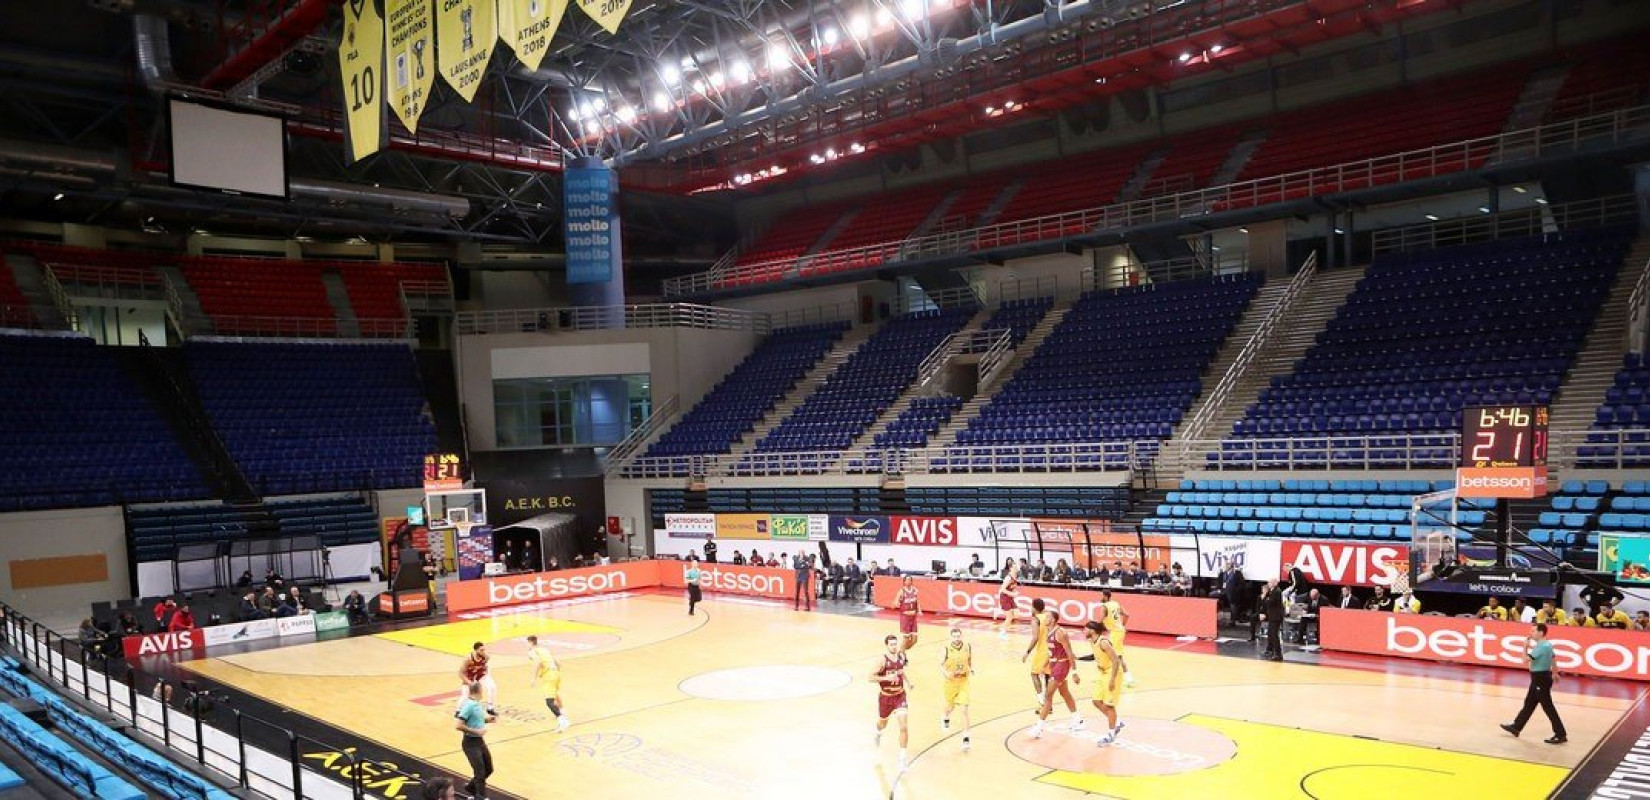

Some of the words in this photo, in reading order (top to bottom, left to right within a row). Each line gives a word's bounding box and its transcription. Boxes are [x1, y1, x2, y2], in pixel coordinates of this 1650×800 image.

[518, 17, 550, 41] ATHENS
[523, 36, 546, 55] 2018
[350, 65, 374, 111] 10
[459, 68, 480, 88] 2000
[1472, 431, 1523, 461] 21
[438, 464, 458, 478] 21
[1462, 476, 1531, 488] betsson
[505, 497, 546, 510] A.E.K.
[548, 496, 576, 509] B.C.
[895, 519, 953, 544] AVIS
[1292, 544, 1399, 586] AVIS
[489, 570, 627, 603] betsson
[1490, 584, 1522, 594] colour
[946, 584, 1105, 622] besson
[139, 631, 193, 655] AVIS
